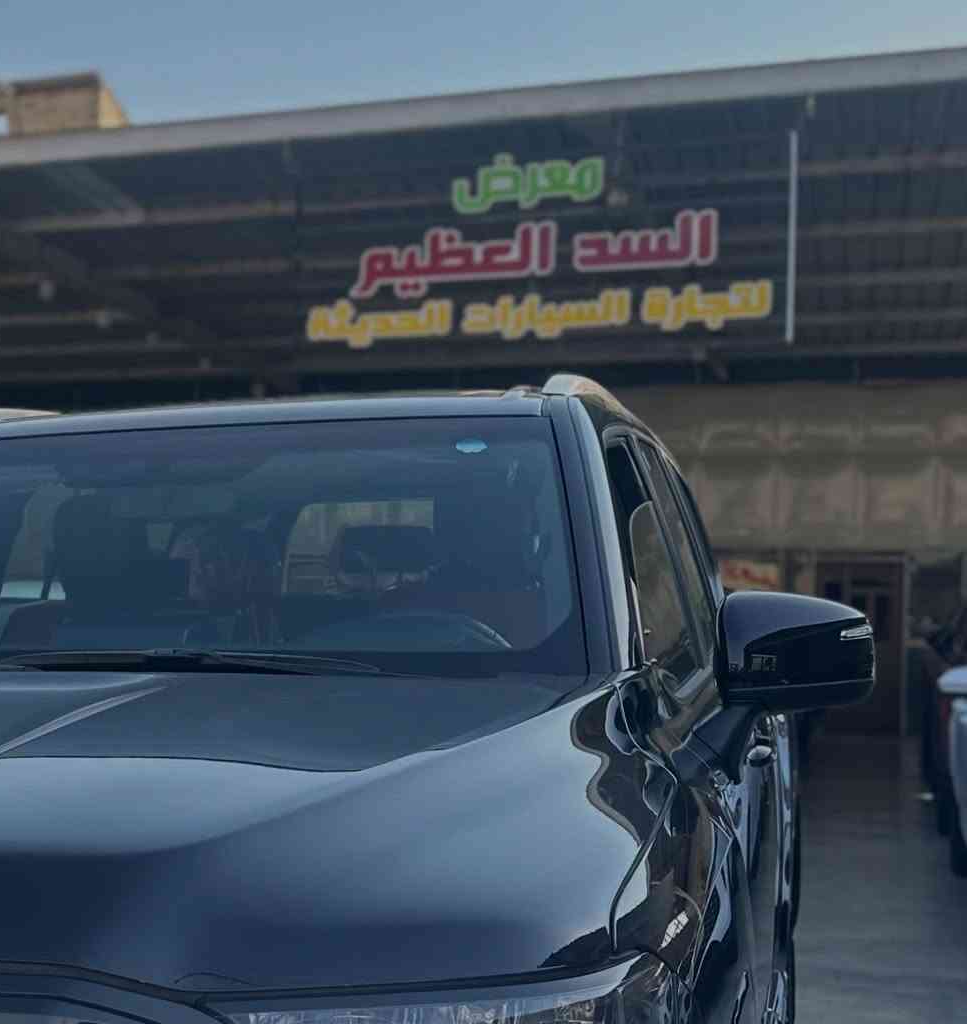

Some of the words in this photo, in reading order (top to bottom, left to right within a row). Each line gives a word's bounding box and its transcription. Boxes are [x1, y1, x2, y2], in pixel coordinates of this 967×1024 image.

[452, 152, 605, 214] معرض
[349, 220, 557, 299] العظيم
[573, 208, 720, 273] السد
[306, 297, 453, 349] الحديثة
[461, 289, 631, 340] السيارات
[641, 278, 774, 332] لتجارة
